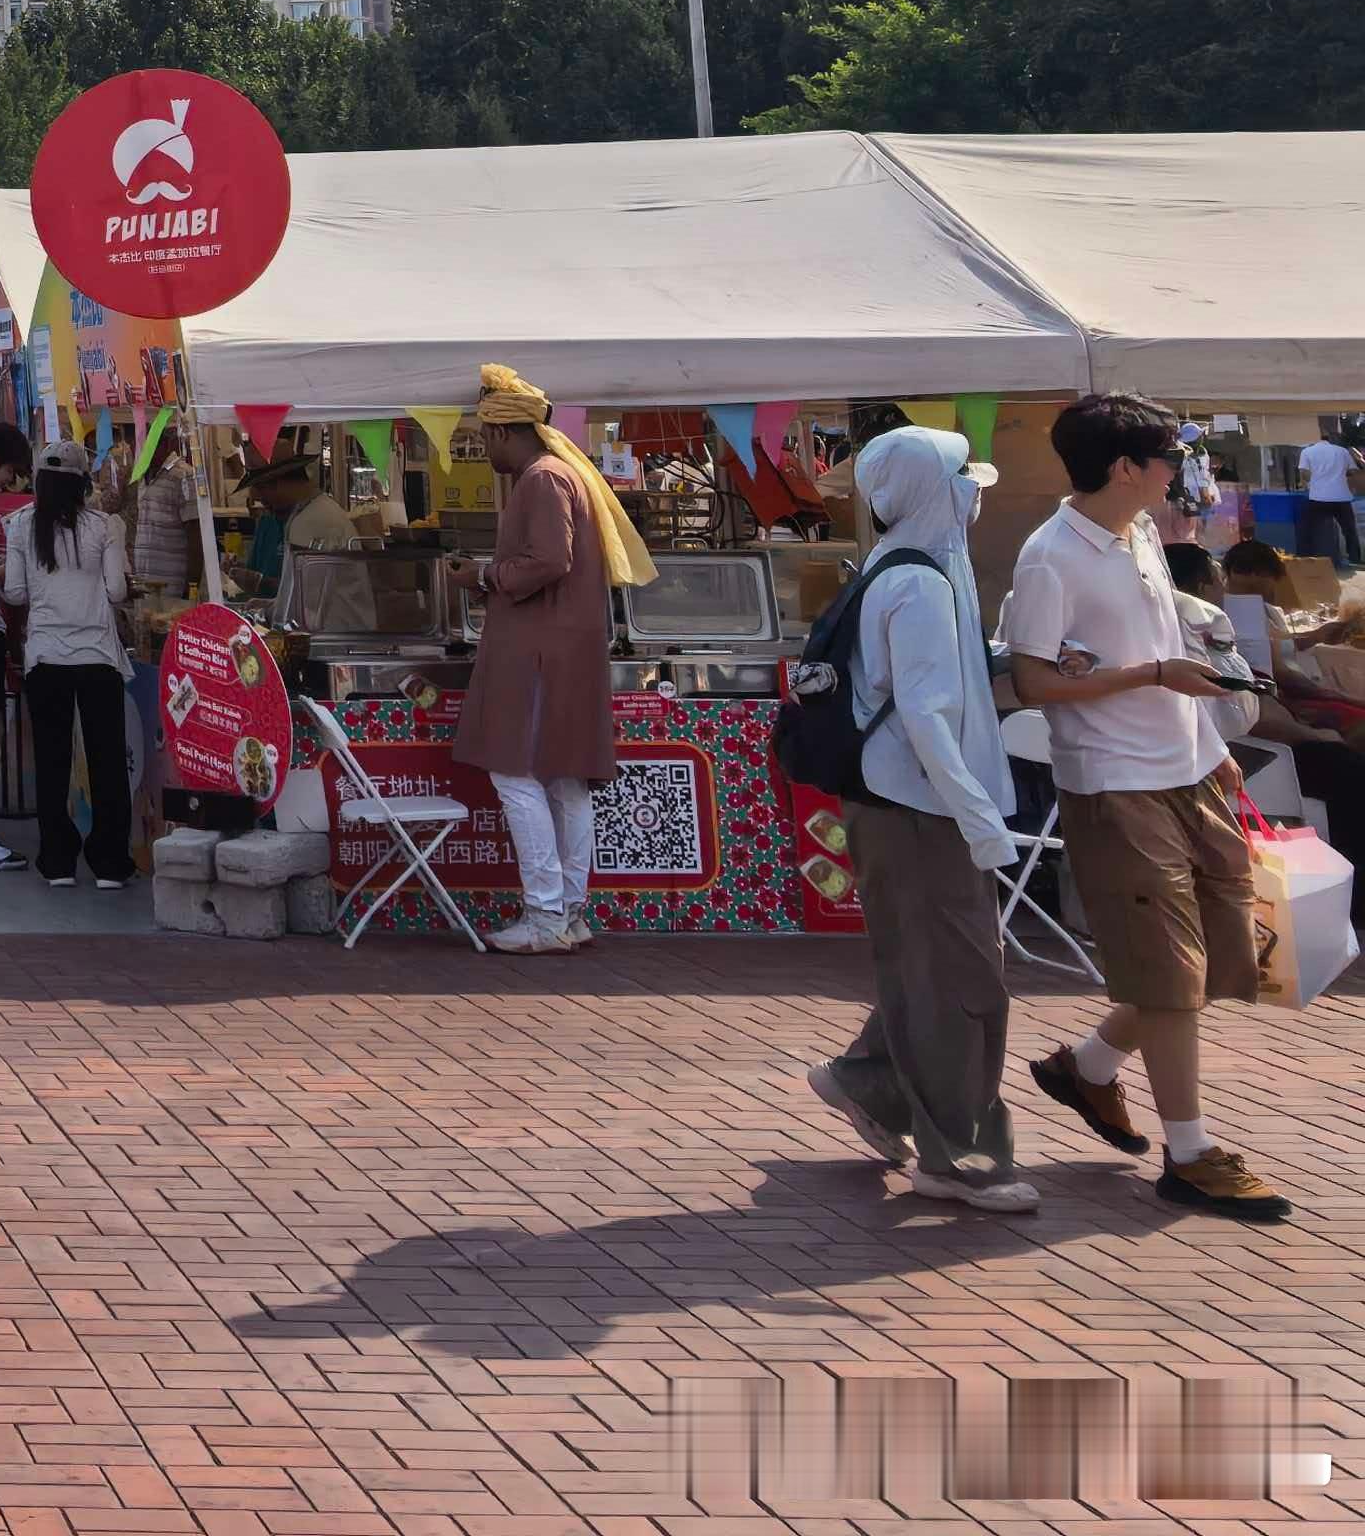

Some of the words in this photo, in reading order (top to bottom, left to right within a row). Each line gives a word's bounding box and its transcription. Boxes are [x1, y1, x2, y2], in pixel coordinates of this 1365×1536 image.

[105, 207, 219, 243] PUNJABI
[338, 839, 516, 866] 朝阳园西路1
